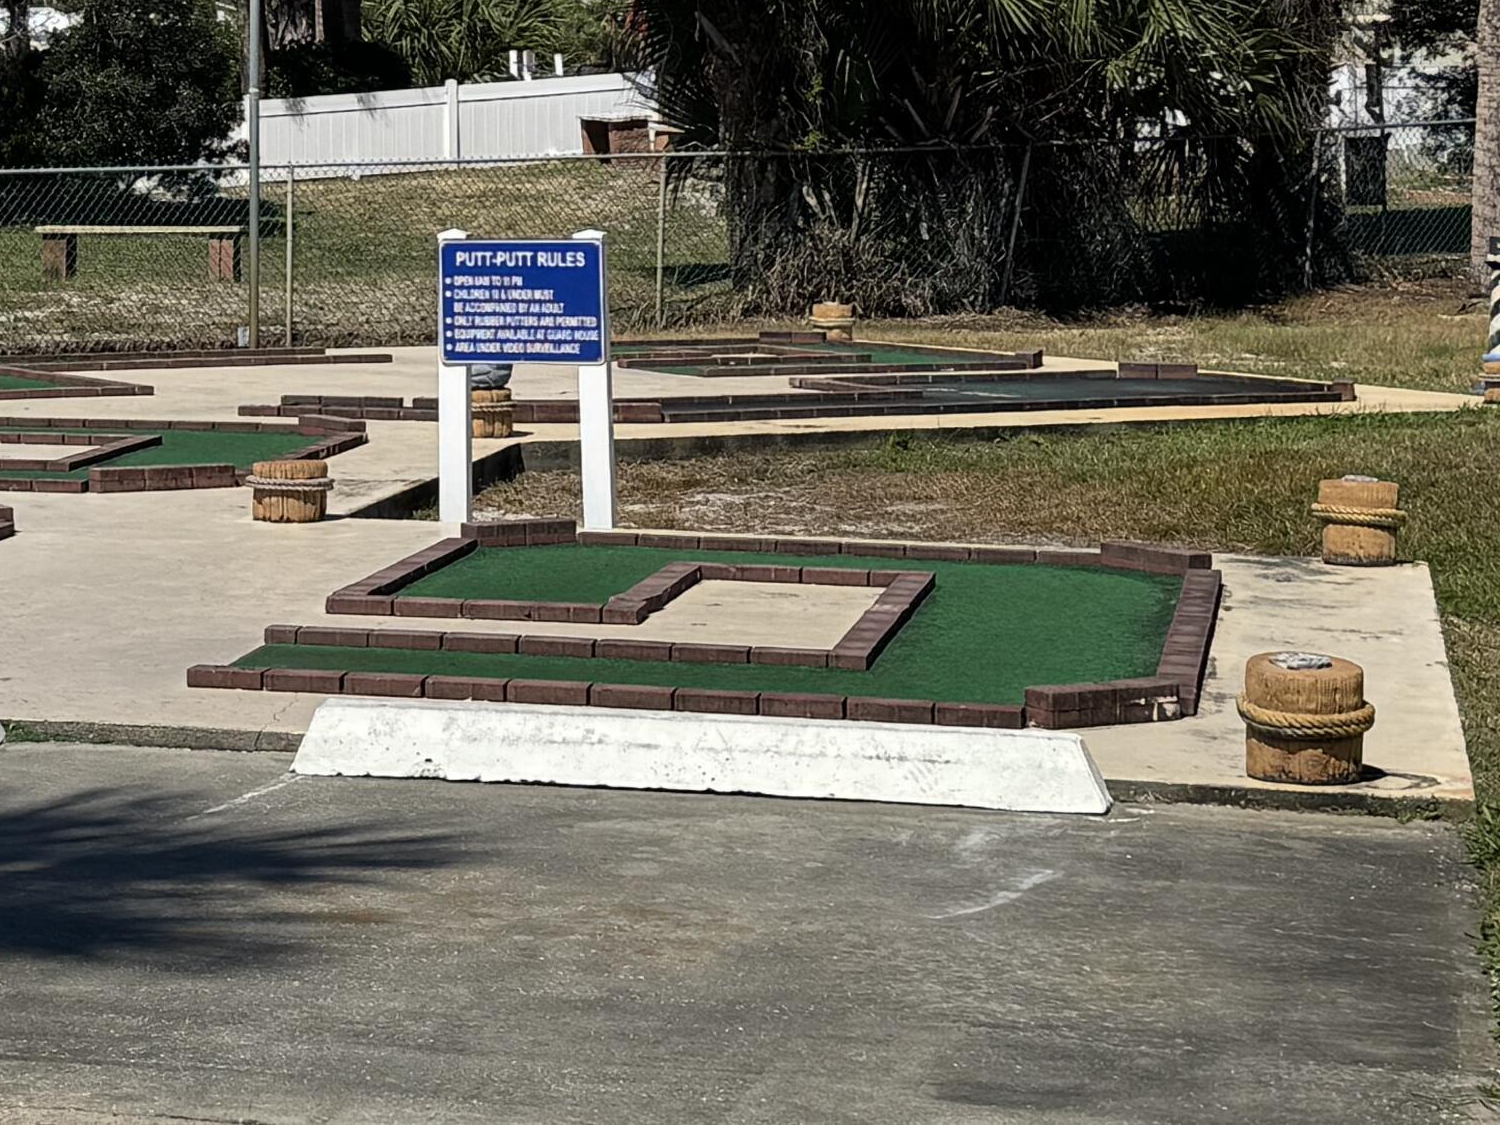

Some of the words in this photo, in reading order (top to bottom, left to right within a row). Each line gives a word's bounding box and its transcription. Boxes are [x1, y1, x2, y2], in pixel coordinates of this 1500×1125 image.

[456, 251, 533, 267] PUTT-PUTT
[537, 251, 586, 267] RULES
[491, 275, 501, 286] TO
[454, 288, 490, 300] CHILDREN
[454, 302, 463, 313] BE
[518, 303, 529, 313] BY
[540, 316, 555, 327] ARE
[555, 316, 597, 328] PERMITTED
[454, 329, 495, 340] EQUIPMENT
[536, 329, 545, 340] AT
[454, 342, 475, 353] AREA
[526, 342, 580, 354] SURVEILLANCE
